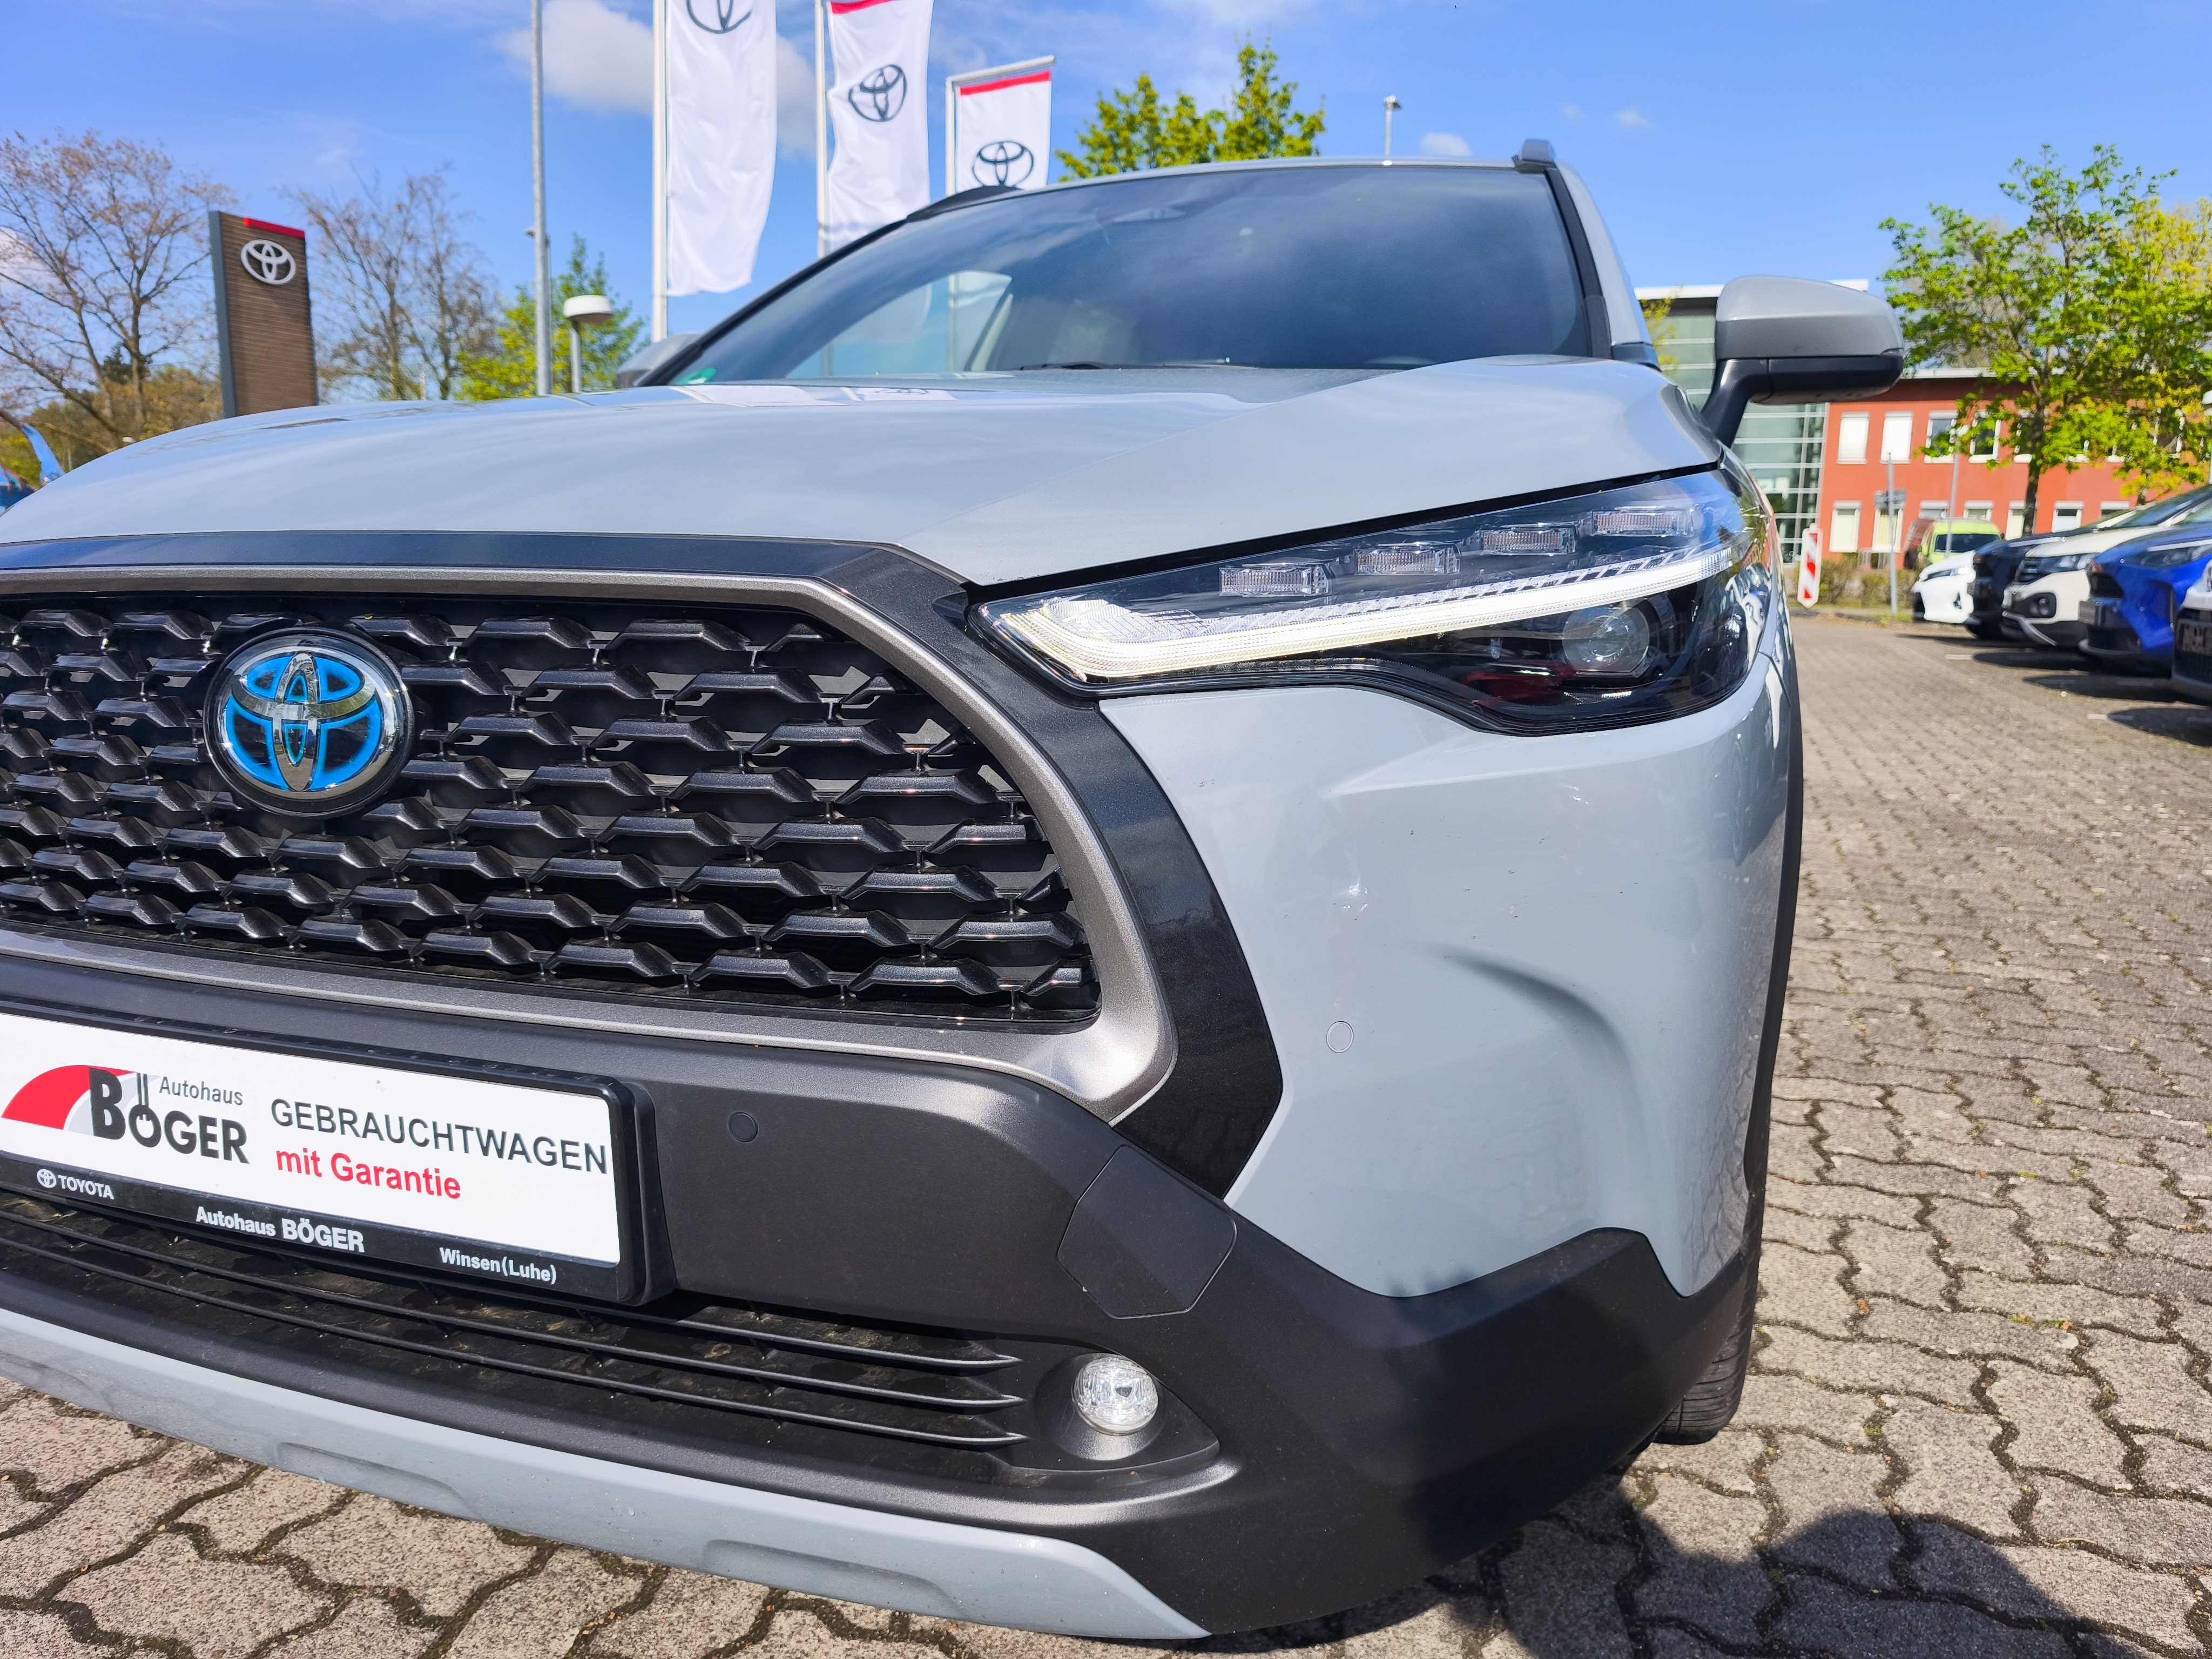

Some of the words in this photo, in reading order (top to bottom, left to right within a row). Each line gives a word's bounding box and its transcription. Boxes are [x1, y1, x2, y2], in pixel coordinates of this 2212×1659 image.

[159, 1076, 244, 1106] Autohaus
[271, 1098, 608, 1175] GEBRAUCHTWAGEN
[57, 1175, 114, 1201] TOYOTA
[276, 1148, 322, 1178] mit
[331, 1152, 461, 1200] Garantie
[195, 1206, 276, 1237] Autohaus
[281, 1217, 366, 1253] BÖGER
